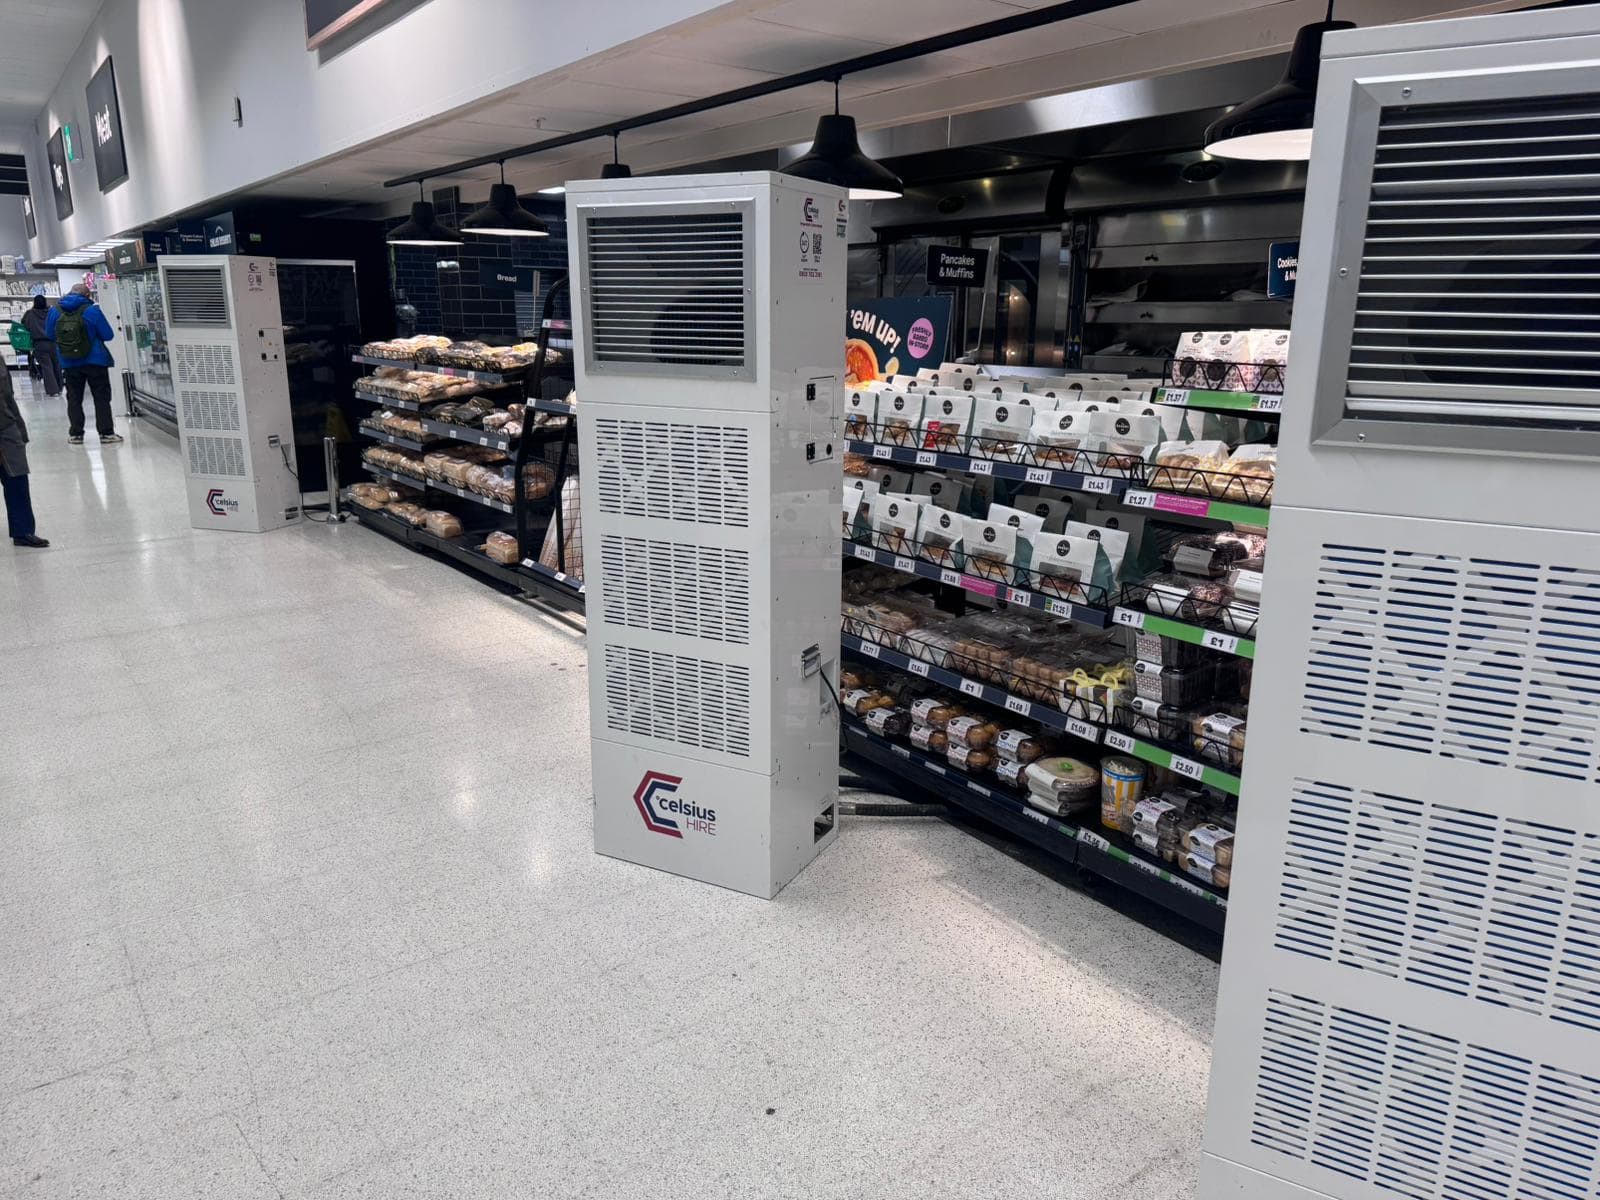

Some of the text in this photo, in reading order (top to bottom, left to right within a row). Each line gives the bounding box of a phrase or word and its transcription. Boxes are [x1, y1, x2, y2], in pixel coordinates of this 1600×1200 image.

[94, 103, 112, 147] Meat
[940, 253, 975, 266] Pancakes
[496, 273, 517, 282] Bread
[939, 266, 974, 279] & Muffins
[1166, 392, 1182, 402] £1.37
[1260, 399, 1279, 409] £1.37
[973, 463, 986, 472] £1.43
[1029, 472, 1044, 482] £1.43
[1088, 480, 1104, 490] £1.43
[1128, 495, 1147, 506] £1.27
[1014, 594, 1024, 603] £1
[1120, 613, 1133, 622] £1
[1210, 637, 1224, 648] £1
[965, 684, 974, 693] £1
[1109, 735, 1127, 749] £2.50
[1175, 761, 1194, 775] £2.50
[685, 817, 716, 836] HIRE
